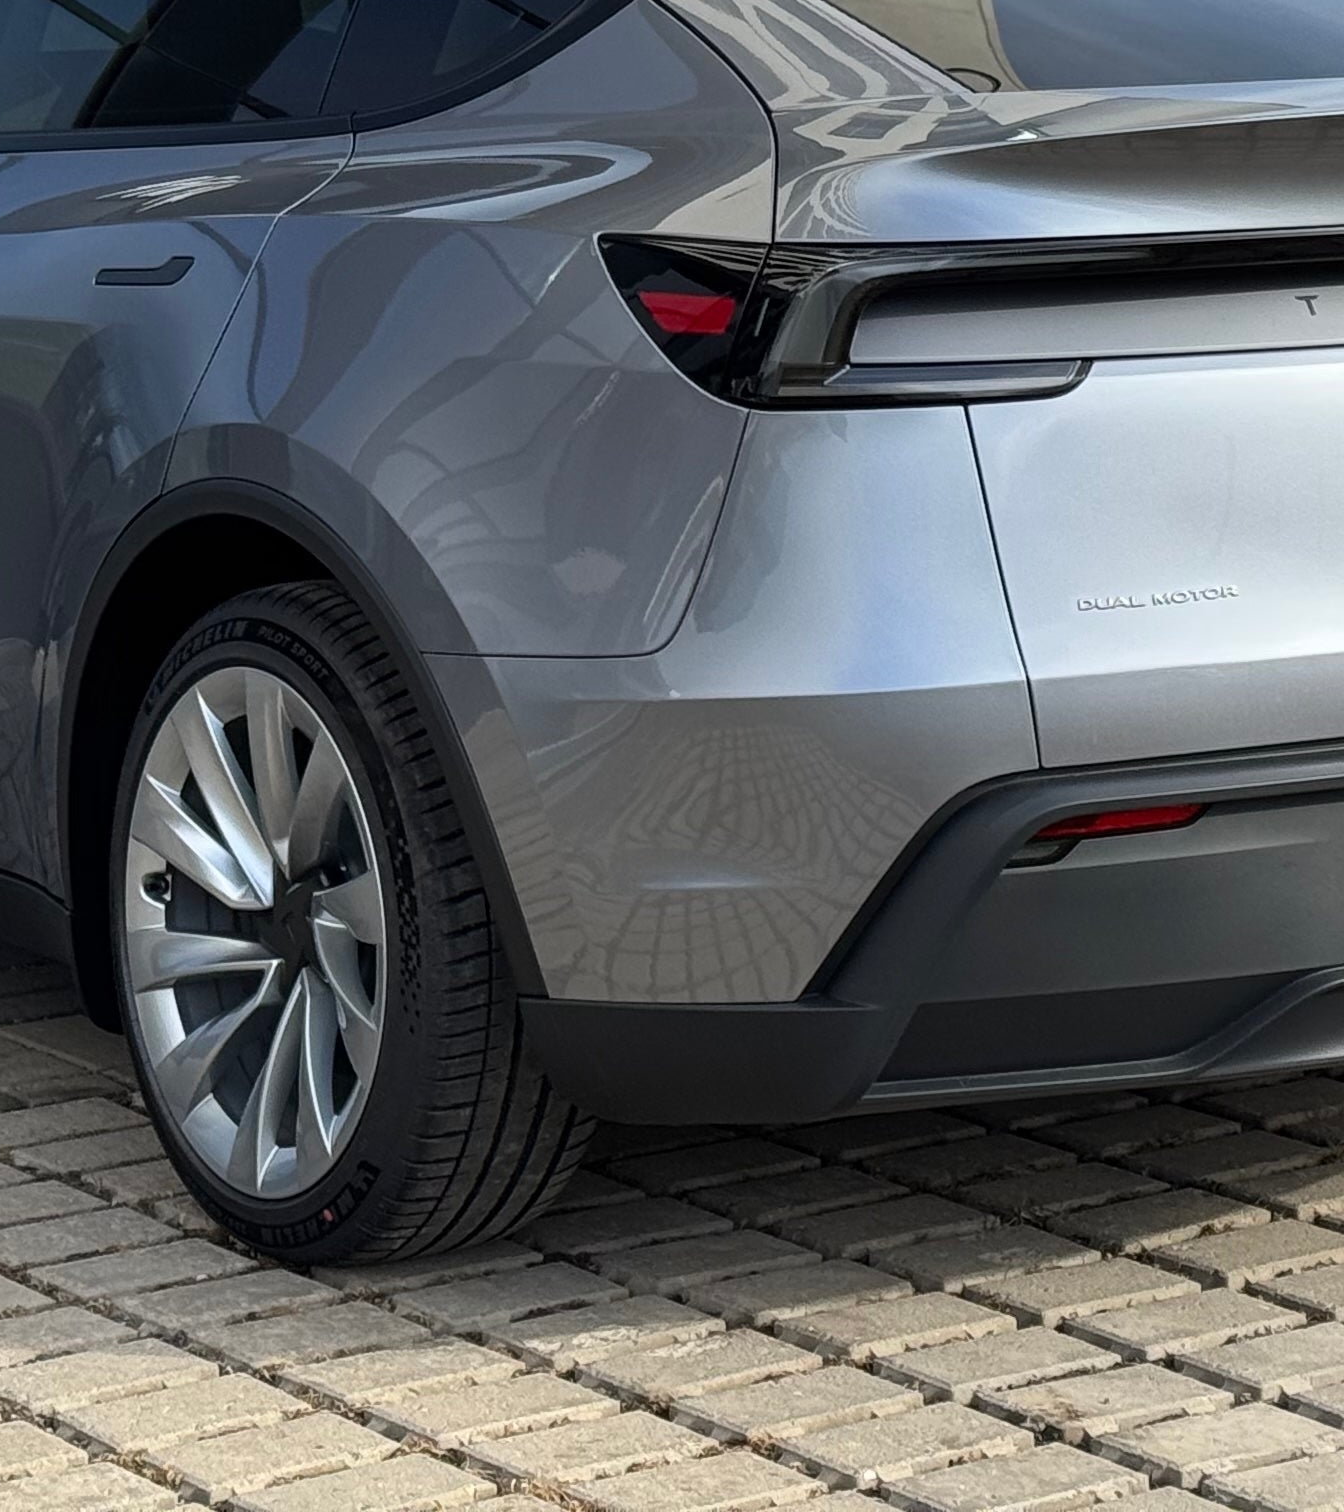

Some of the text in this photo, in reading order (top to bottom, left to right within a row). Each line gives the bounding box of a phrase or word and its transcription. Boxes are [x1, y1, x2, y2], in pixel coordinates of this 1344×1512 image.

[1076, 584, 1240, 612] DUAL MOTOR
[257, 625, 291, 648] PILOT
[291, 642, 330, 679] SPORT
